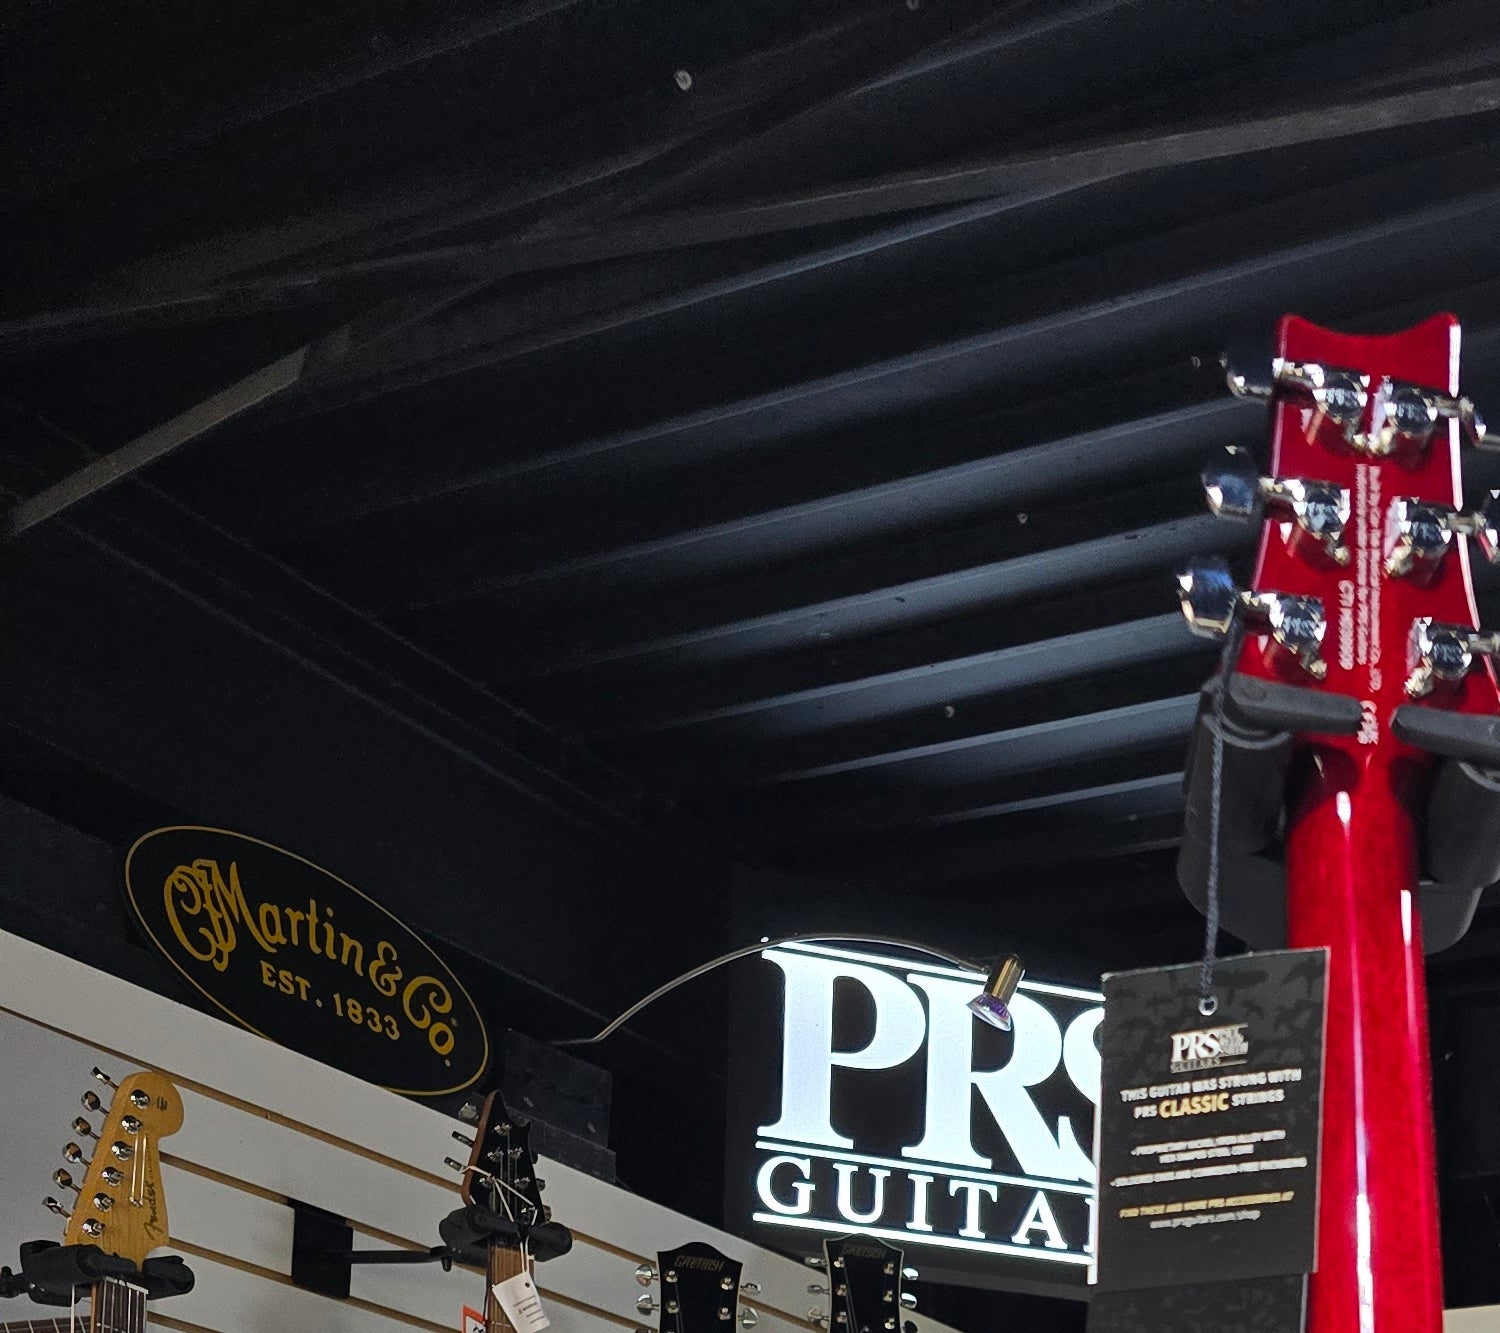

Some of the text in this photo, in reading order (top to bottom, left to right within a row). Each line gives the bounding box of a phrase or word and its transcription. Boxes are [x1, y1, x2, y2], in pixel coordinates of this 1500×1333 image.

[333, 993, 400, 1041] 1833
[1171, 1033, 1223, 1061] PRS
[1120, 1068, 1301, 1102] THIS GUITAR WAS STRUNG WITH
[1134, 1089, 1285, 1119] PRS CLASSIC STRINGS
[143, 1178, 163, 1242] Fender
[756, 1155, 1098, 1254] GUITA
[674, 1255, 725, 1272] GRETSCH
